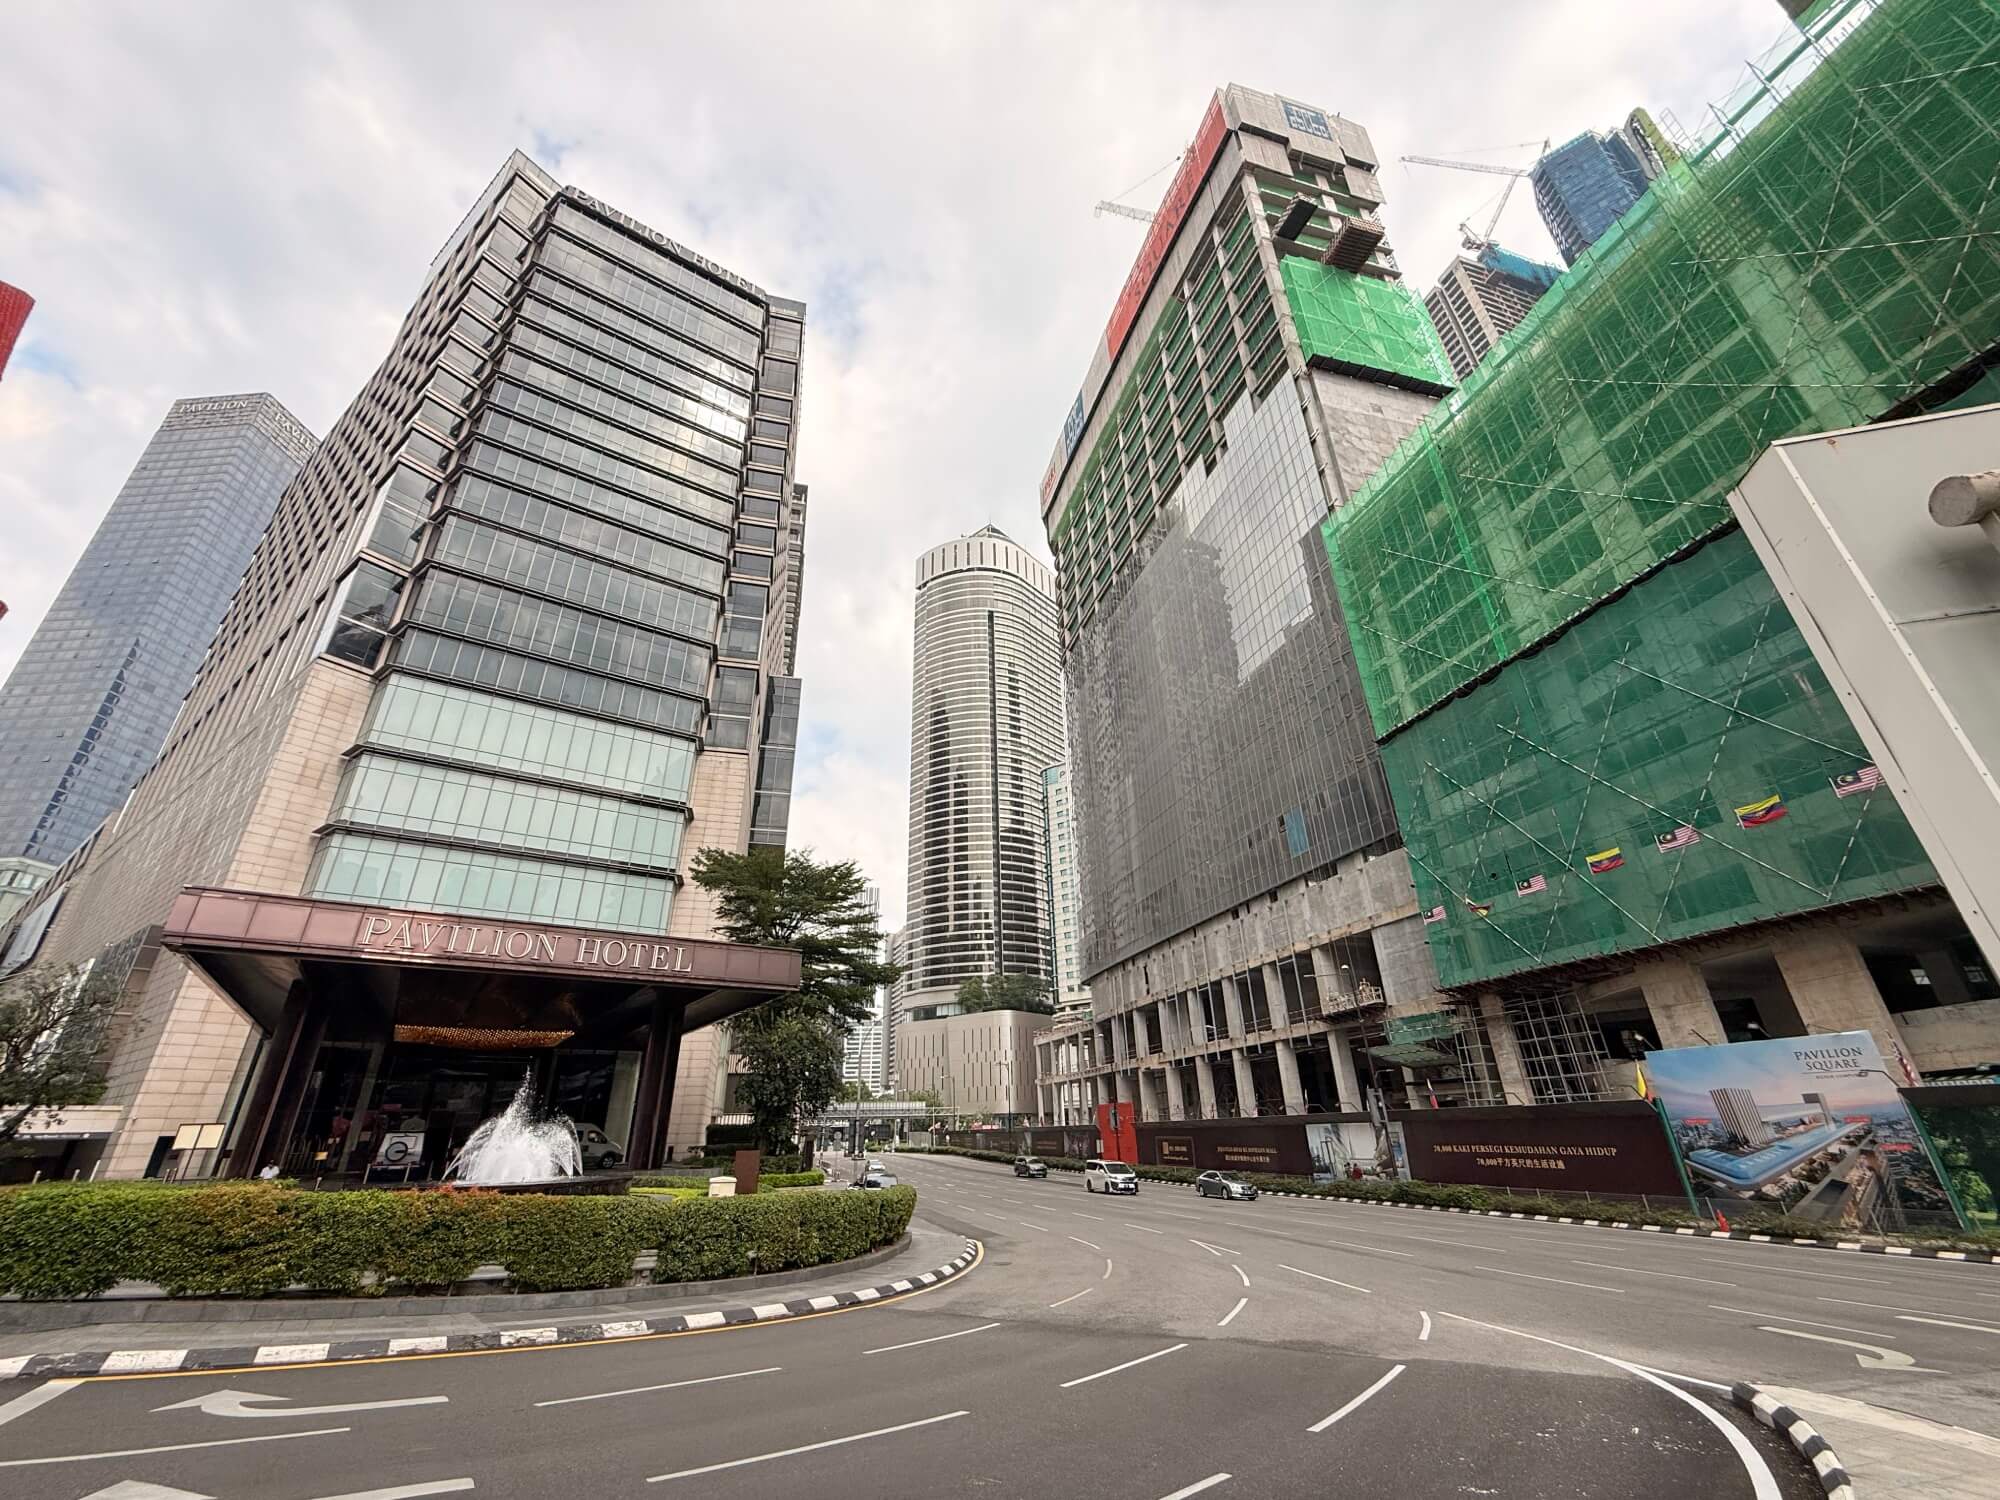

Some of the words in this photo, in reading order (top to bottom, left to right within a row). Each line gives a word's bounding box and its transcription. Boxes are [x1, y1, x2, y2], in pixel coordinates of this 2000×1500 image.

[574, 187, 683, 256] PAVILION
[694, 252, 766, 301] HOTEL
[180, 400, 248, 413] PAVILION
[361, 916, 562, 962] PAVILION
[573, 937, 693, 973] HOTEL
[1793, 1047, 1863, 1061] PAVILION
[1805, 1059, 1861, 1072] SQUARE
[1453, 1145, 1470, 1153] KAKI
[1472, 1145, 1503, 1153] PERSEGI
[1505, 1145, 1558, 1155] KEMUDAHAN
[1560, 1146, 1584, 1155] GAYA
[1585, 1147, 1616, 1157] HIDUP
